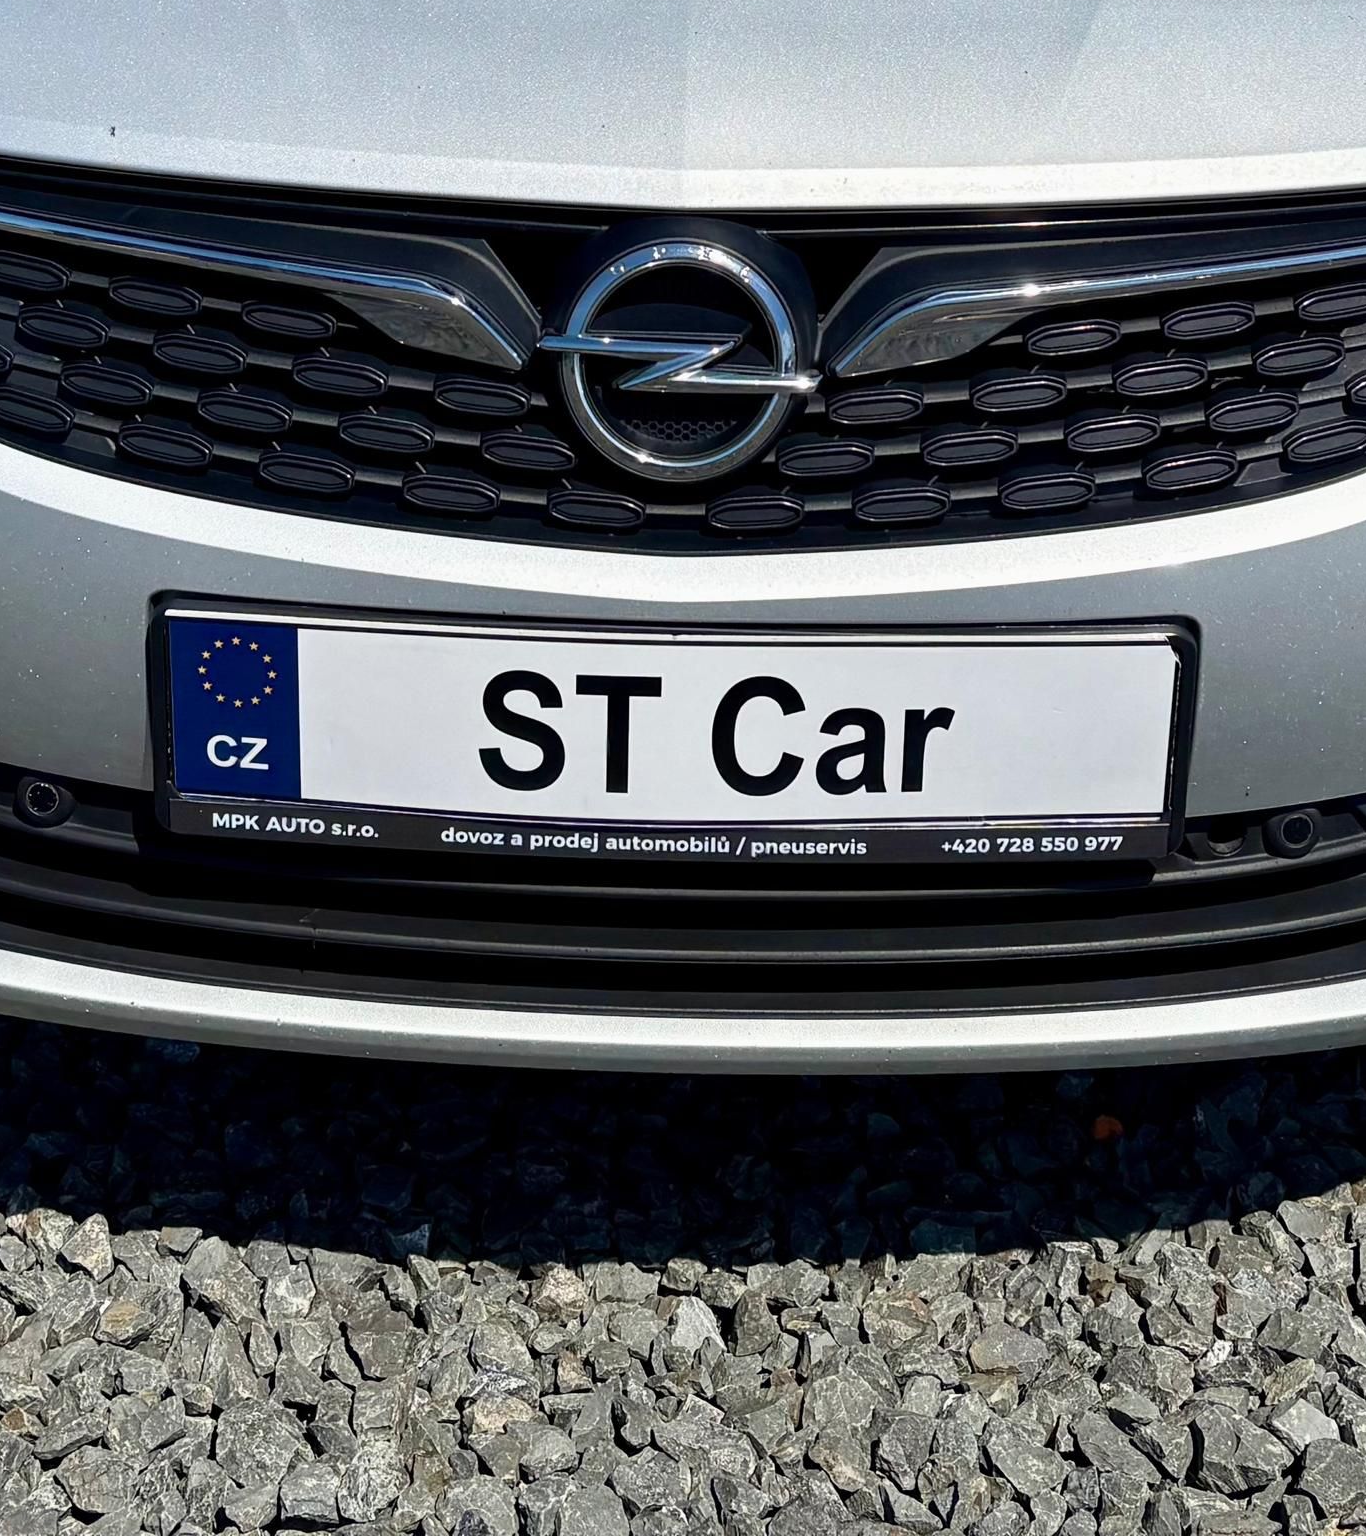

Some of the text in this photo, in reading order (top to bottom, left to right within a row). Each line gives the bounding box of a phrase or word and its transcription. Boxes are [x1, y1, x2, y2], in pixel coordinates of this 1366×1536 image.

[207, 670, 955, 796] CZ ST Car
[212, 813, 379, 838] MPK AUTO s.r.o.
[440, 827, 505, 845] dovoz
[510, 833, 523, 846] a
[530, 832, 599, 853] prodej
[605, 836, 730, 853] automobilů
[751, 838, 867, 857] pneuservis
[941, 836, 1123, 853] +420 728 550 977
